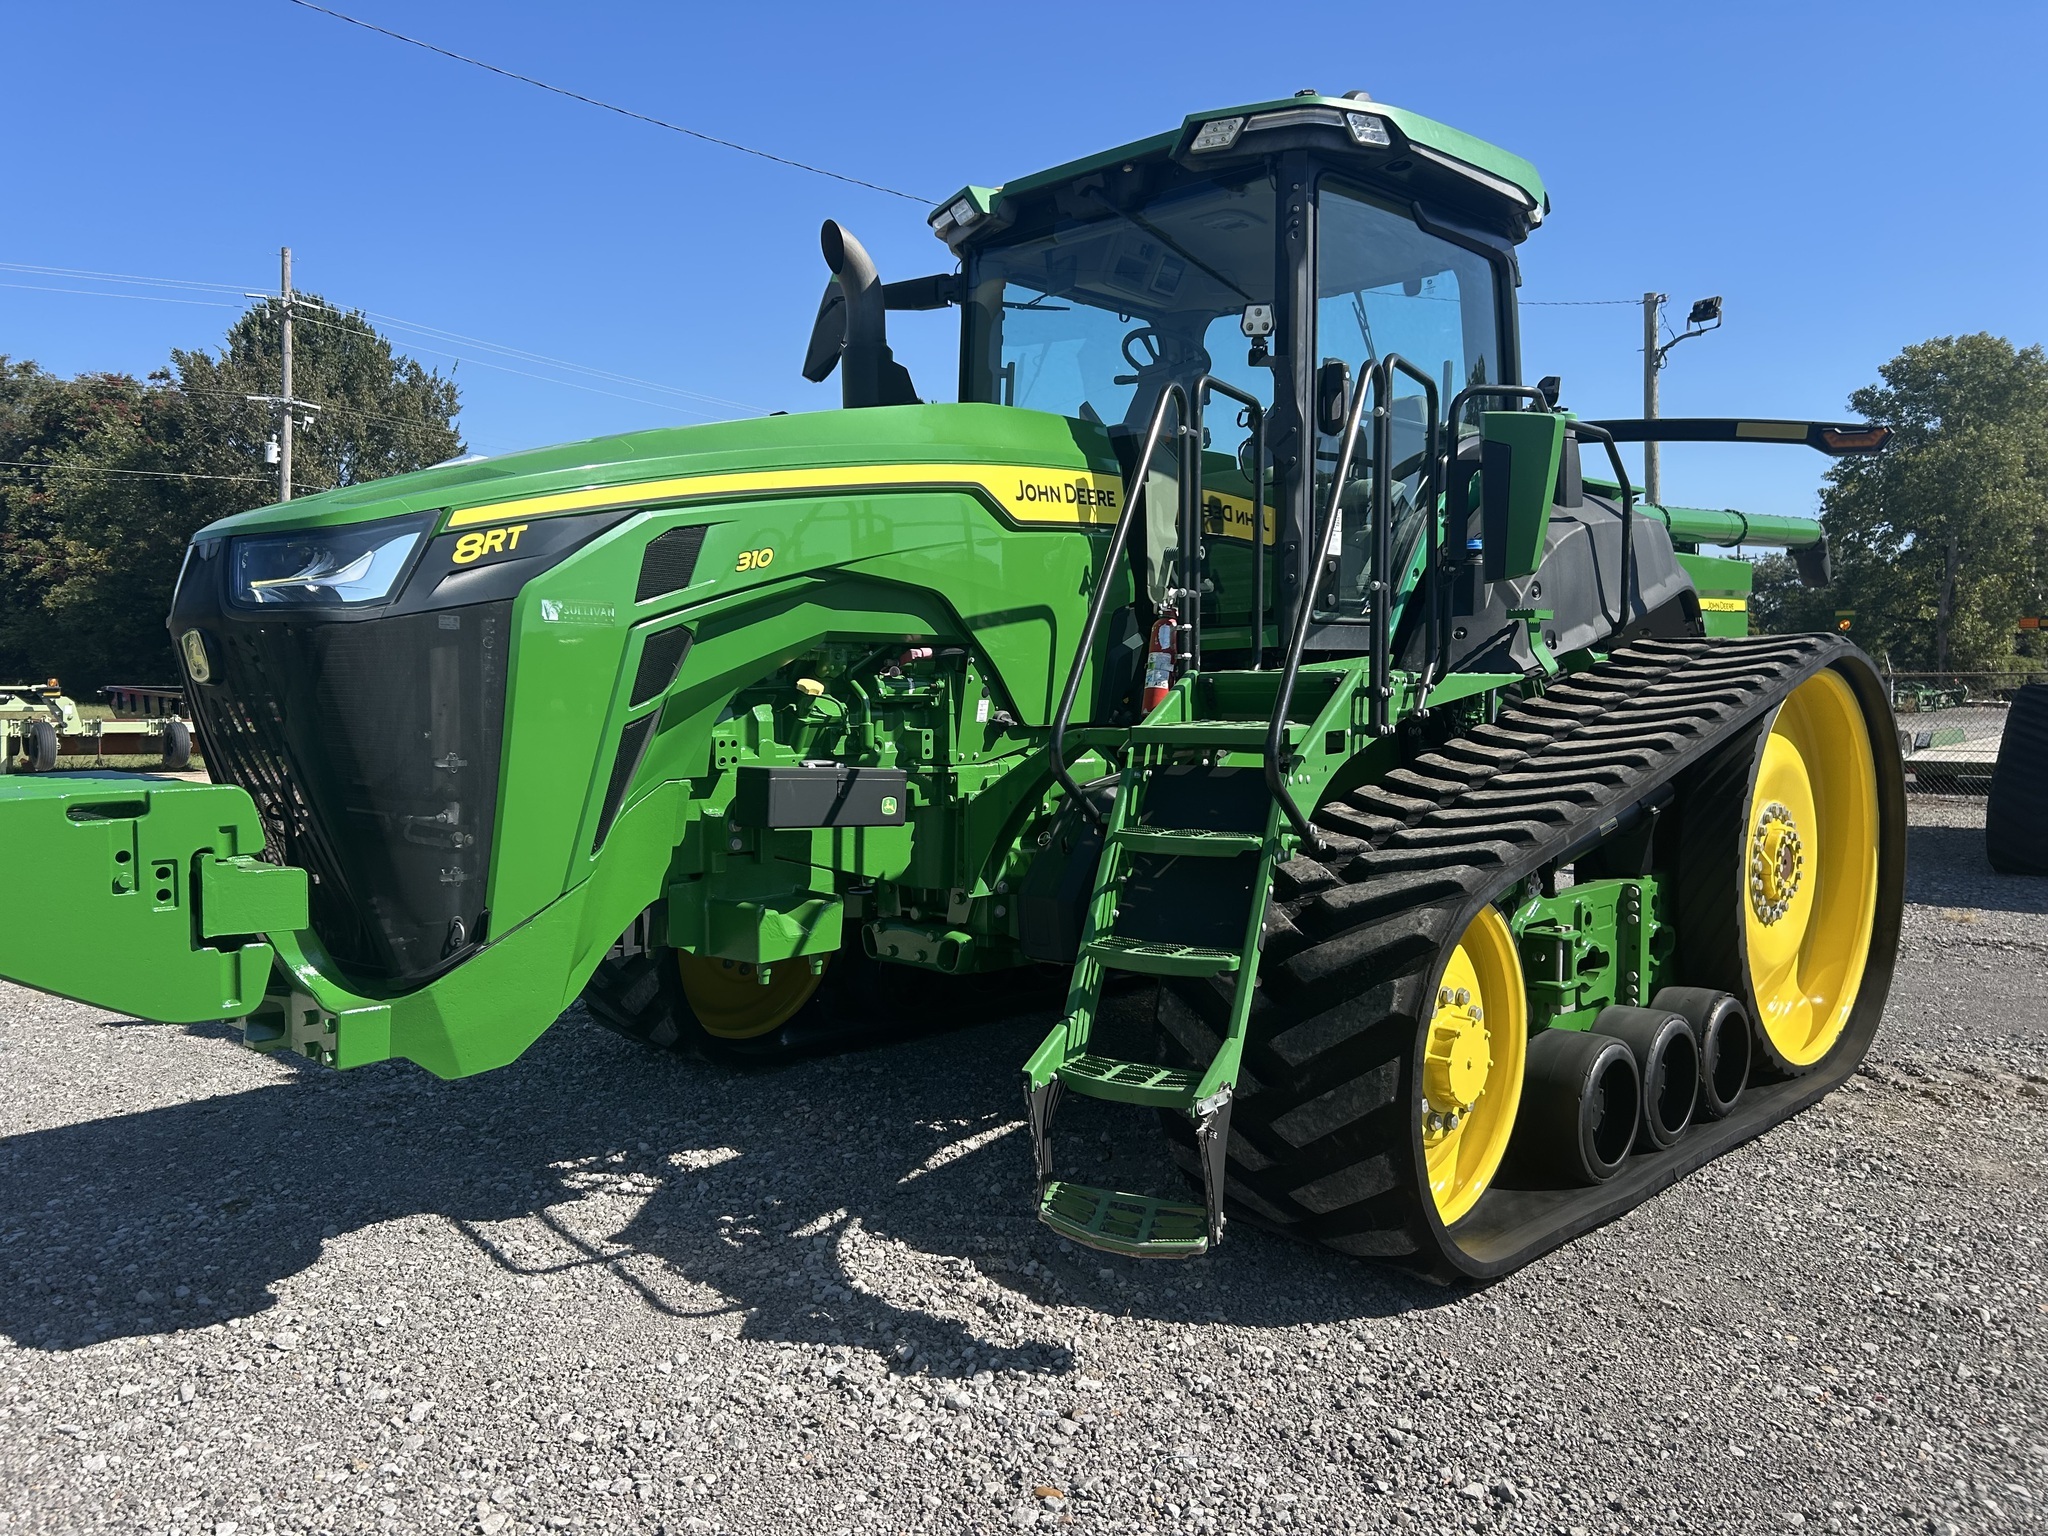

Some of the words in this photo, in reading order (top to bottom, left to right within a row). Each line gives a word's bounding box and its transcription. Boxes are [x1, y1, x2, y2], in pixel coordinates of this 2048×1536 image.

[1016, 480, 1061, 503] JOHN
[1064, 483, 1116, 507] DEERE
[452, 525, 528, 564] 8RT
[735, 547, 774, 572] 310
[564, 605, 615, 617] SULLIVAN
[1707, 601, 1720, 609] JOHN
[1720, 601, 1734, 610] DEERE
